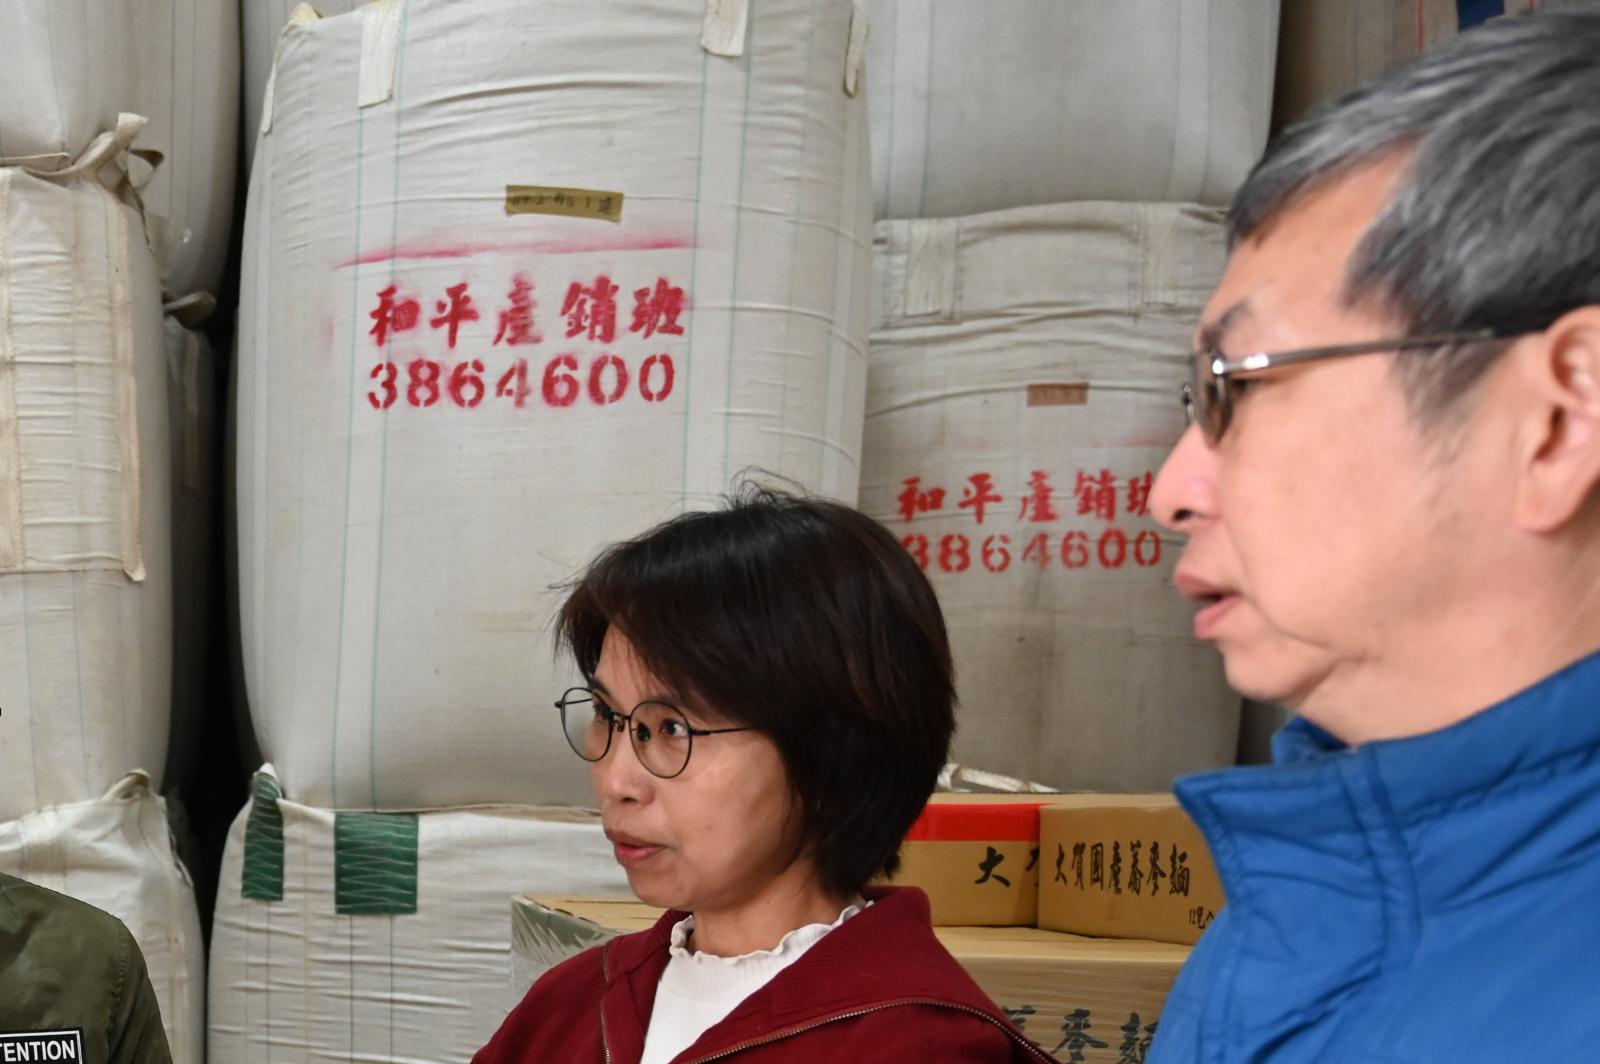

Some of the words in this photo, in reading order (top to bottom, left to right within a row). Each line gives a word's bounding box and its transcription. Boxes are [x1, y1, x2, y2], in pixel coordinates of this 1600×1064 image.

[369, 272, 687, 348] 和平產銷班
[367, 354, 676, 409] 3864600
